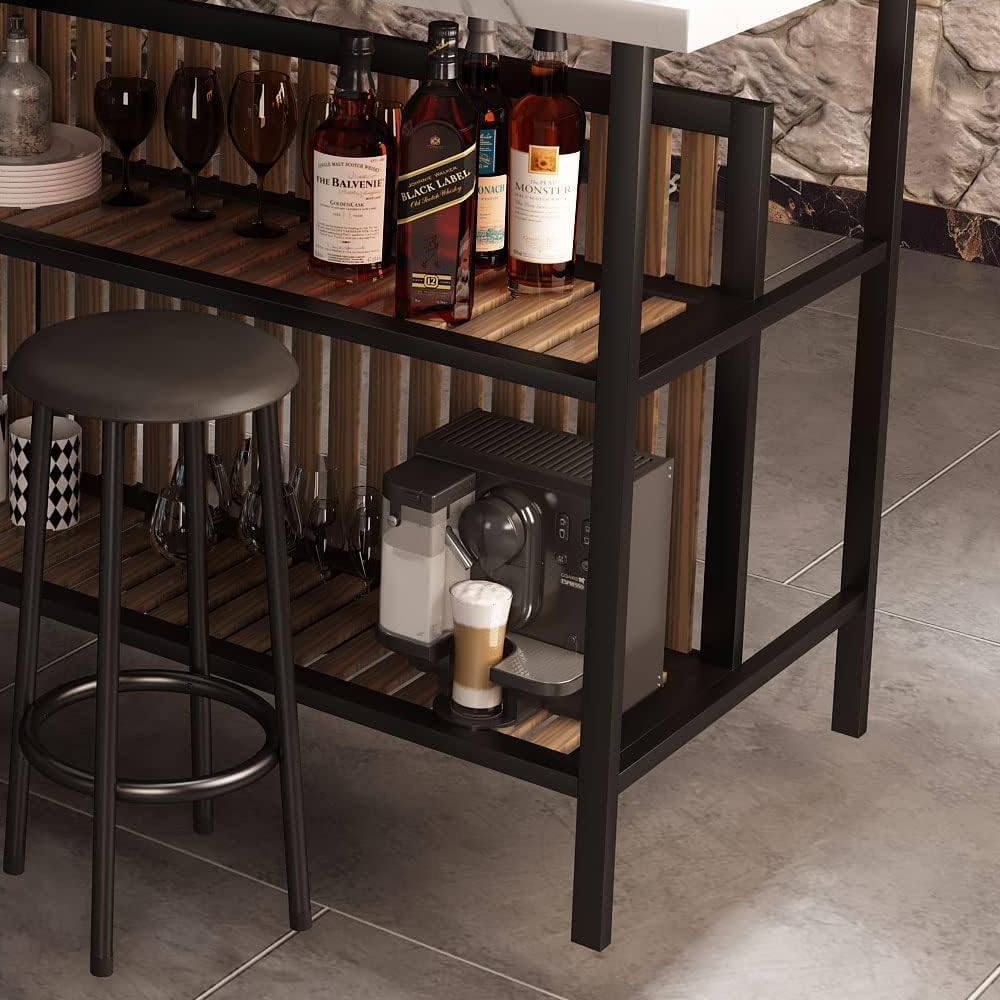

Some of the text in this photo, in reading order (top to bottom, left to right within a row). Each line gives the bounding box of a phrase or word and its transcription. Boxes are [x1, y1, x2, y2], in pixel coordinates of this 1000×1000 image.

[316, 176, 384, 189] THE BALVENIE
[401, 169, 471, 202] BLACK LABEL
[515, 182, 571, 195] MONSTER
[410, 200, 421, 208] Old
[427, 277, 436, 285] 12
